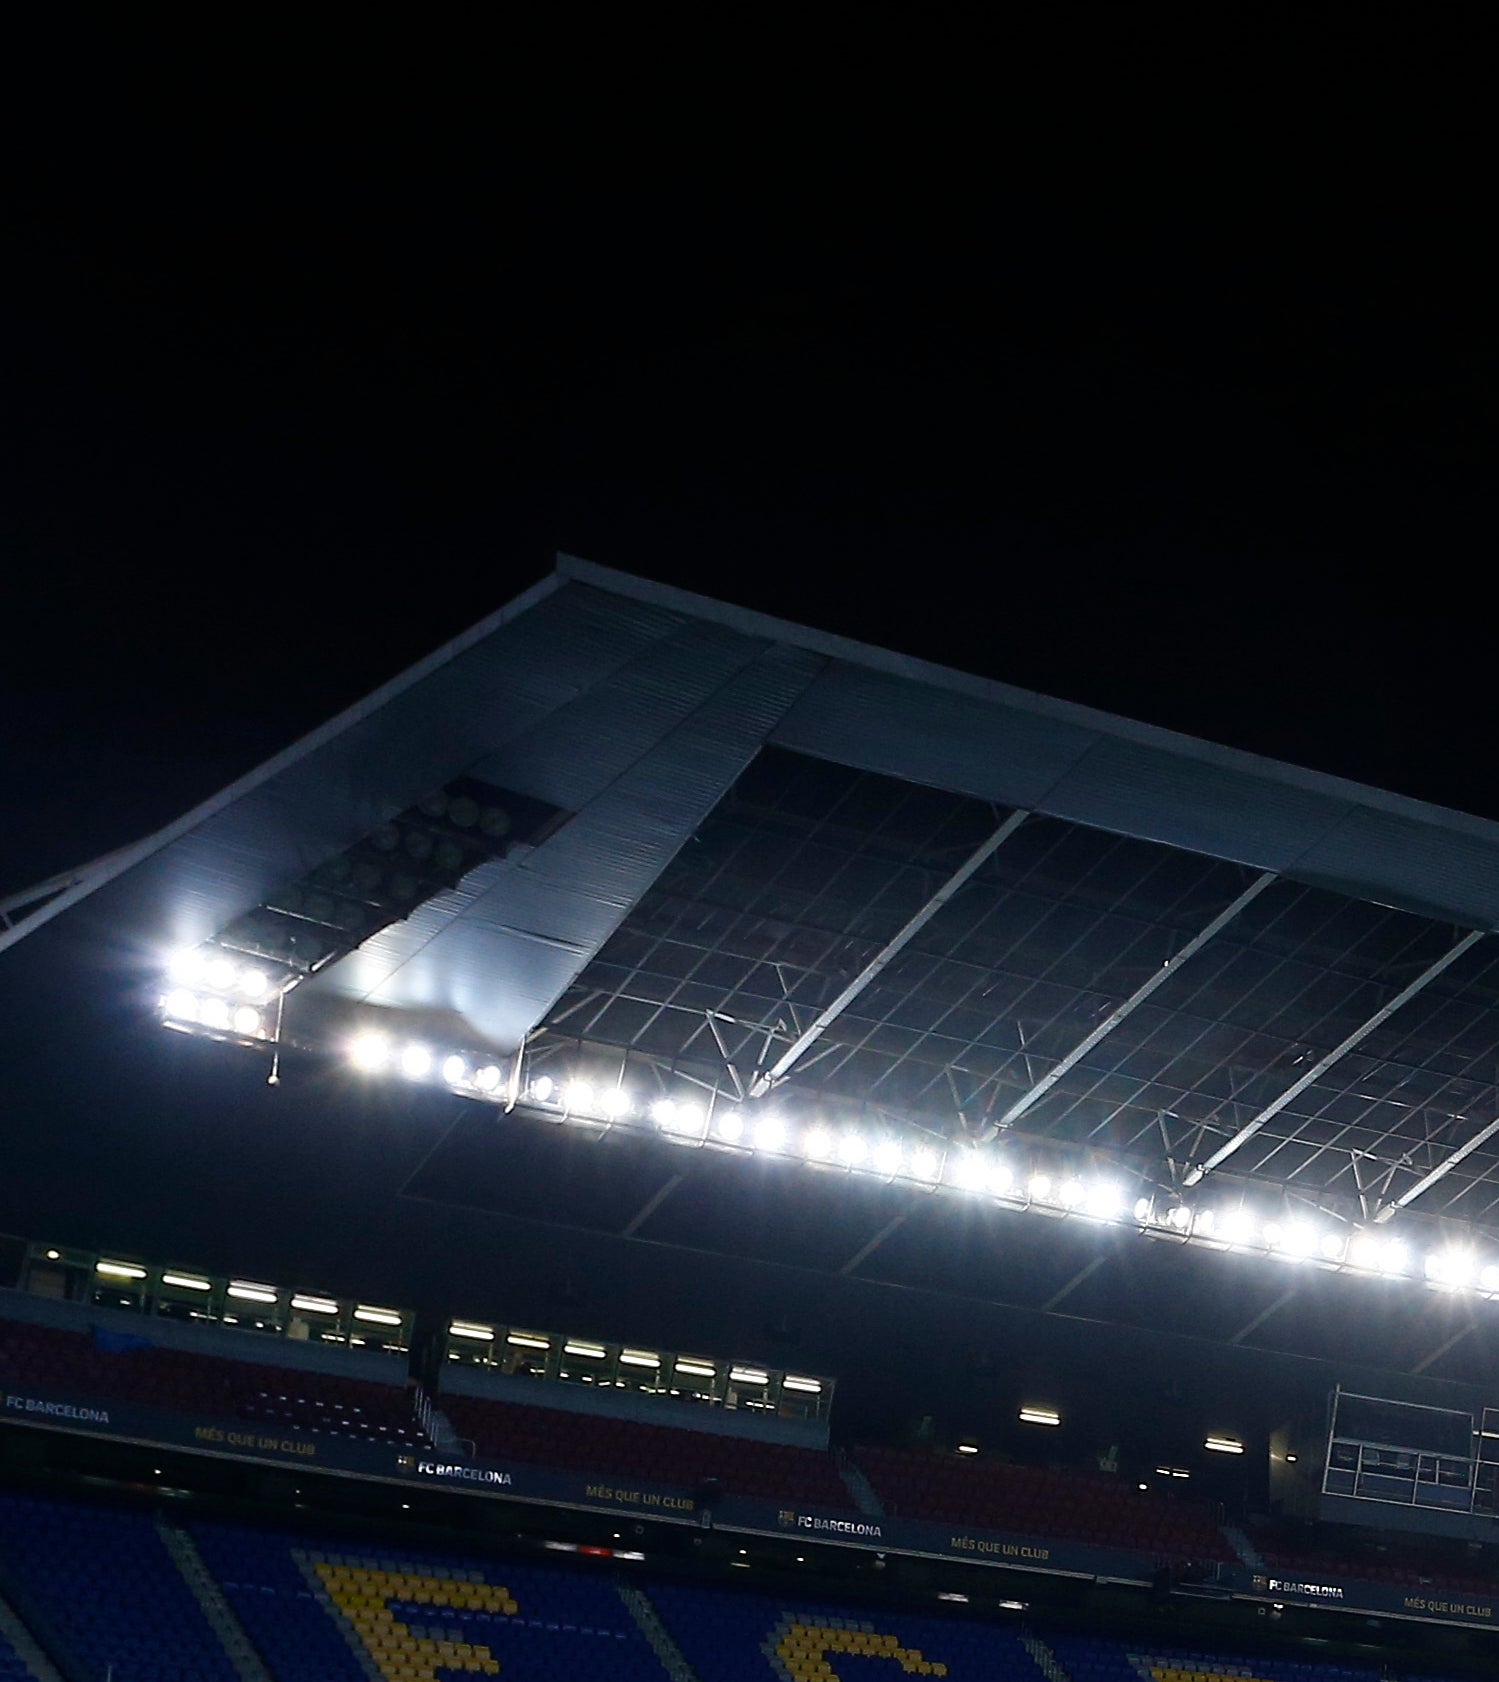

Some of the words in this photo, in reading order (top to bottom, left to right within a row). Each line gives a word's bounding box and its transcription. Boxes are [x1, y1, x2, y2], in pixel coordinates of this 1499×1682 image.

[7, 1396, 23, 1410] FC
[26, 1398, 110, 1424] BARCELONA
[195, 1426, 223, 1441] MÉS
[227, 1432, 254, 1445] QUE
[259, 1435, 275, 1450] UN
[279, 1439, 315, 1455] CLUB
[418, 1461, 434, 1475] FC
[436, 1463, 512, 1485] BARCELONA
[585, 1484, 612, 1498] MÉS
[616, 1488, 640, 1502] QUE
[644, 1492, 660, 1506] UN
[663, 1495, 694, 1511] CLUB
[798, 1516, 812, 1528] FC
[814, 1518, 881, 1537] BARCELONA
[951, 1536, 974, 1550] MÉS
[978, 1540, 999, 1554] QUE
[1003, 1544, 1017, 1556] UN
[1020, 1546, 1048, 1560] CLUB
[1269, 1580, 1282, 1592] FC
[1283, 1581, 1343, 1598] BARCELONA
[1404, 1597, 1426, 1610] MÉS
[1428, 1601, 1447, 1613] QUE
[1450, 1604, 1464, 1614] UN
[1466, 1606, 1491, 1618] CLUB
